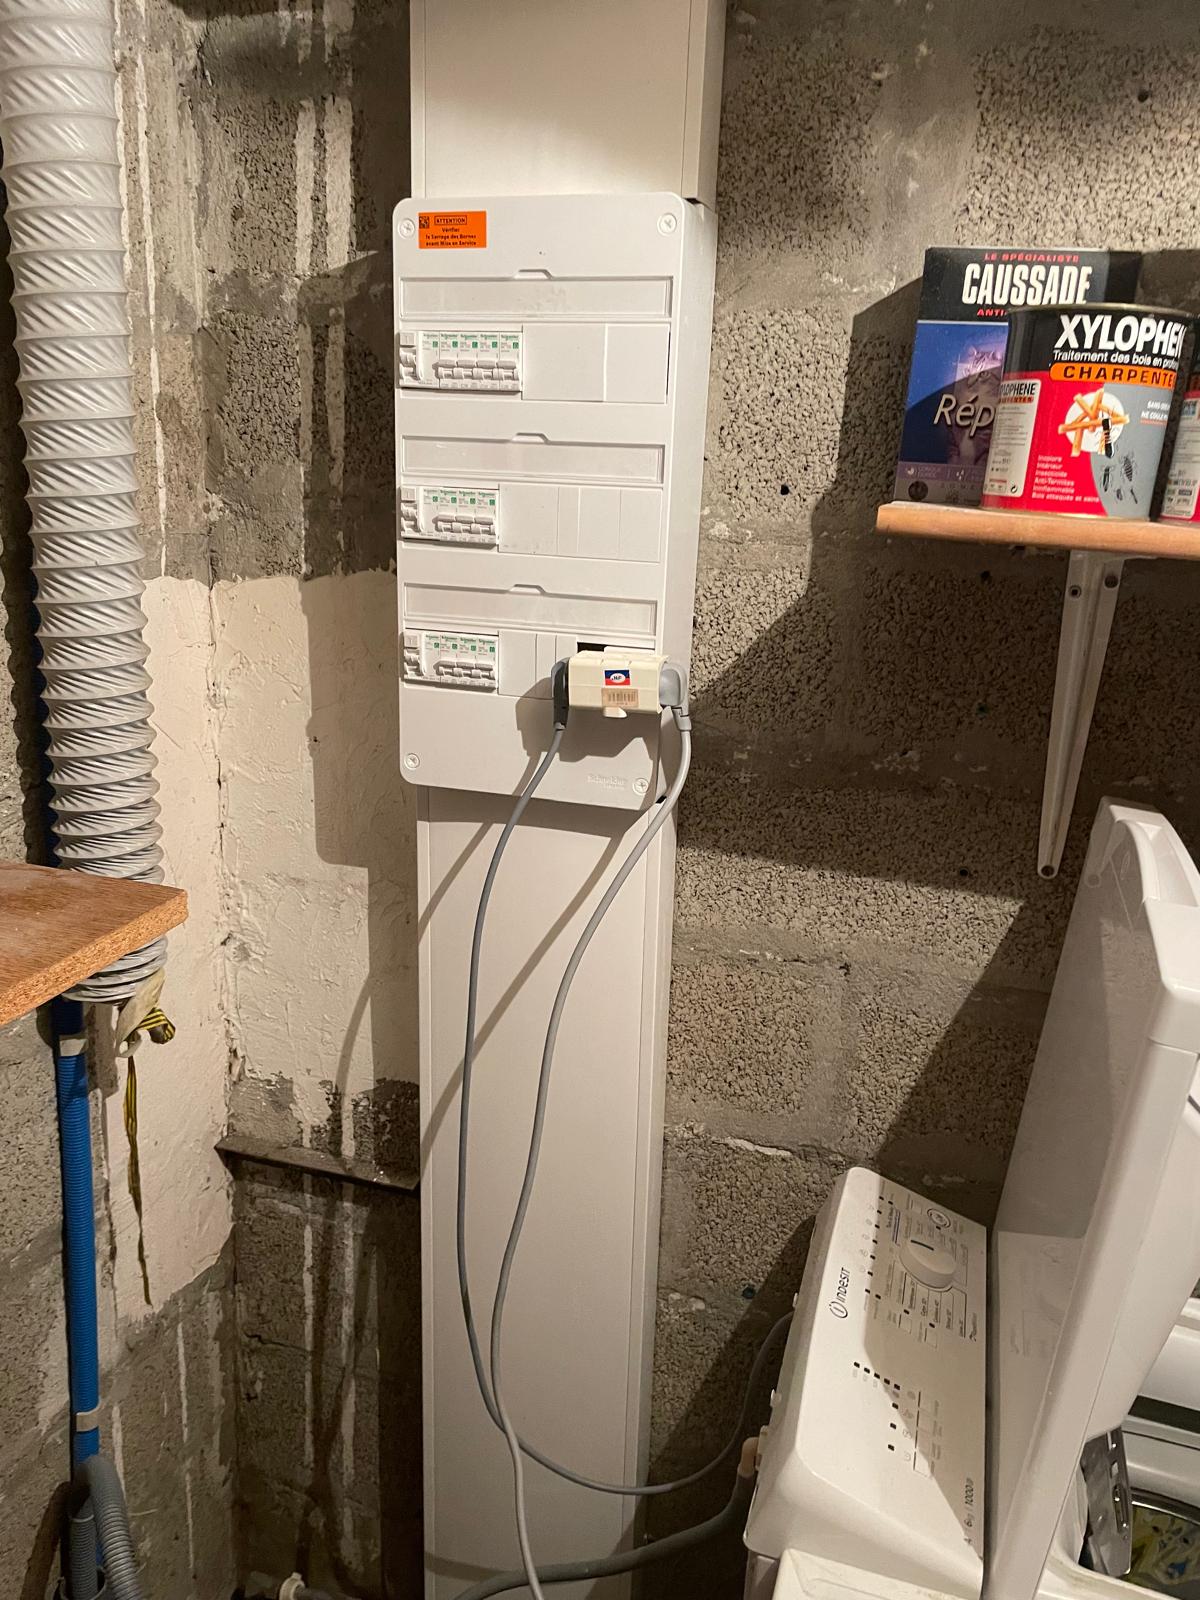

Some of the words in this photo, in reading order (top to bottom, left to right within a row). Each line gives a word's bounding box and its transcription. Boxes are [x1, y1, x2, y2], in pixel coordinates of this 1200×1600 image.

[984, 252, 997, 261] LE
[1002, 252, 1079, 264] SPÉCIALISTE
[962, 262, 1093, 306] CAUSSADE
[1053, 349, 1108, 363] Traitement
[1110, 352, 1130, 364] des
[1133, 352, 1152, 367] bois
